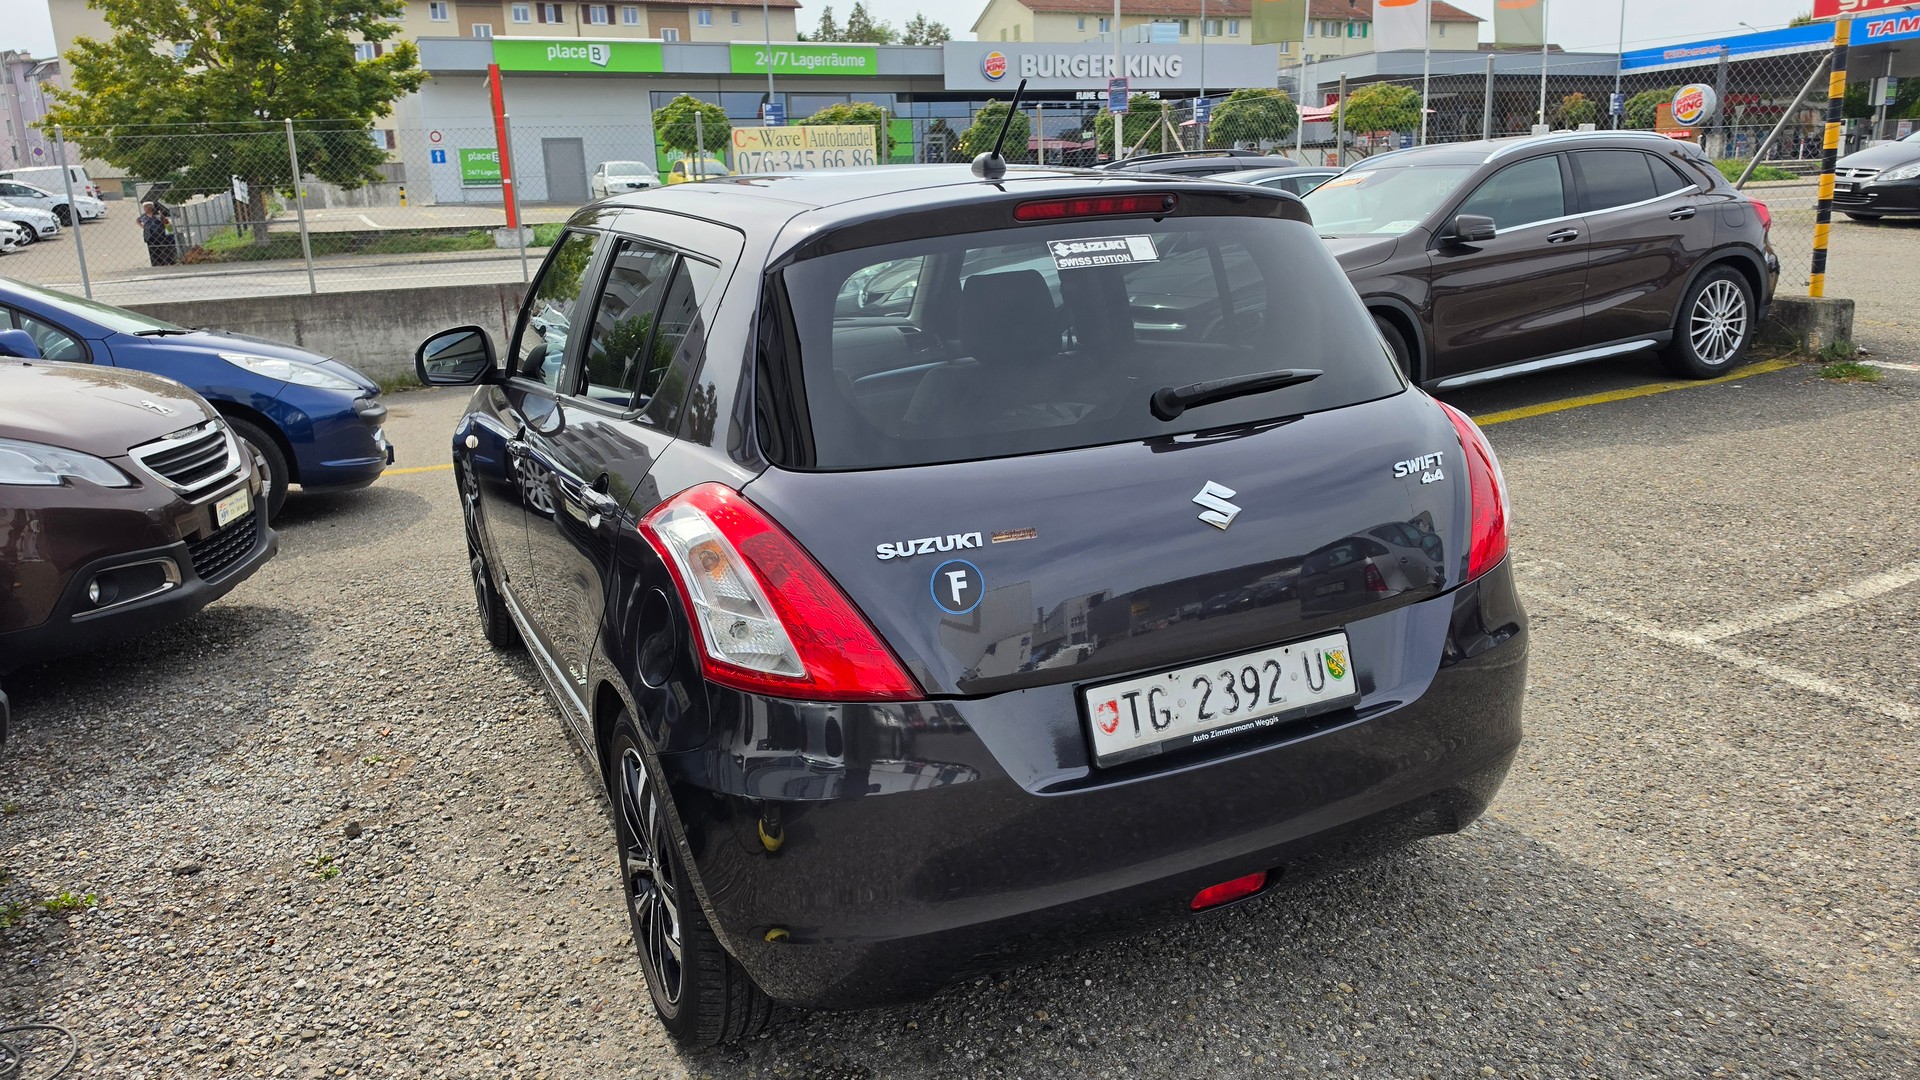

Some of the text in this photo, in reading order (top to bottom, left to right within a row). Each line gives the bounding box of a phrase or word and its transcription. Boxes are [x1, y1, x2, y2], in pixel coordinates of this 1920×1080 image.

[755, 51, 866, 70] 24/7 Lagerräume
[1020, 54, 1183, 79] BURGER KING
[1675, 91, 1703, 106] BURGER
[1675, 99, 1703, 117] KING
[809, 128, 873, 147] Autohandel
[1069, 240, 1127, 254] SUZUKI
[1059, 253, 1131, 268] SWISS EDITION
[1393, 451, 1444, 479] SWIFT
[876, 531, 984, 561] SUZUKI
[944, 569, 968, 606] F
[1121, 648, 1326, 738] TG 2392 U
[1192, 715, 1280, 743] Auto Zimmermann Weggis
